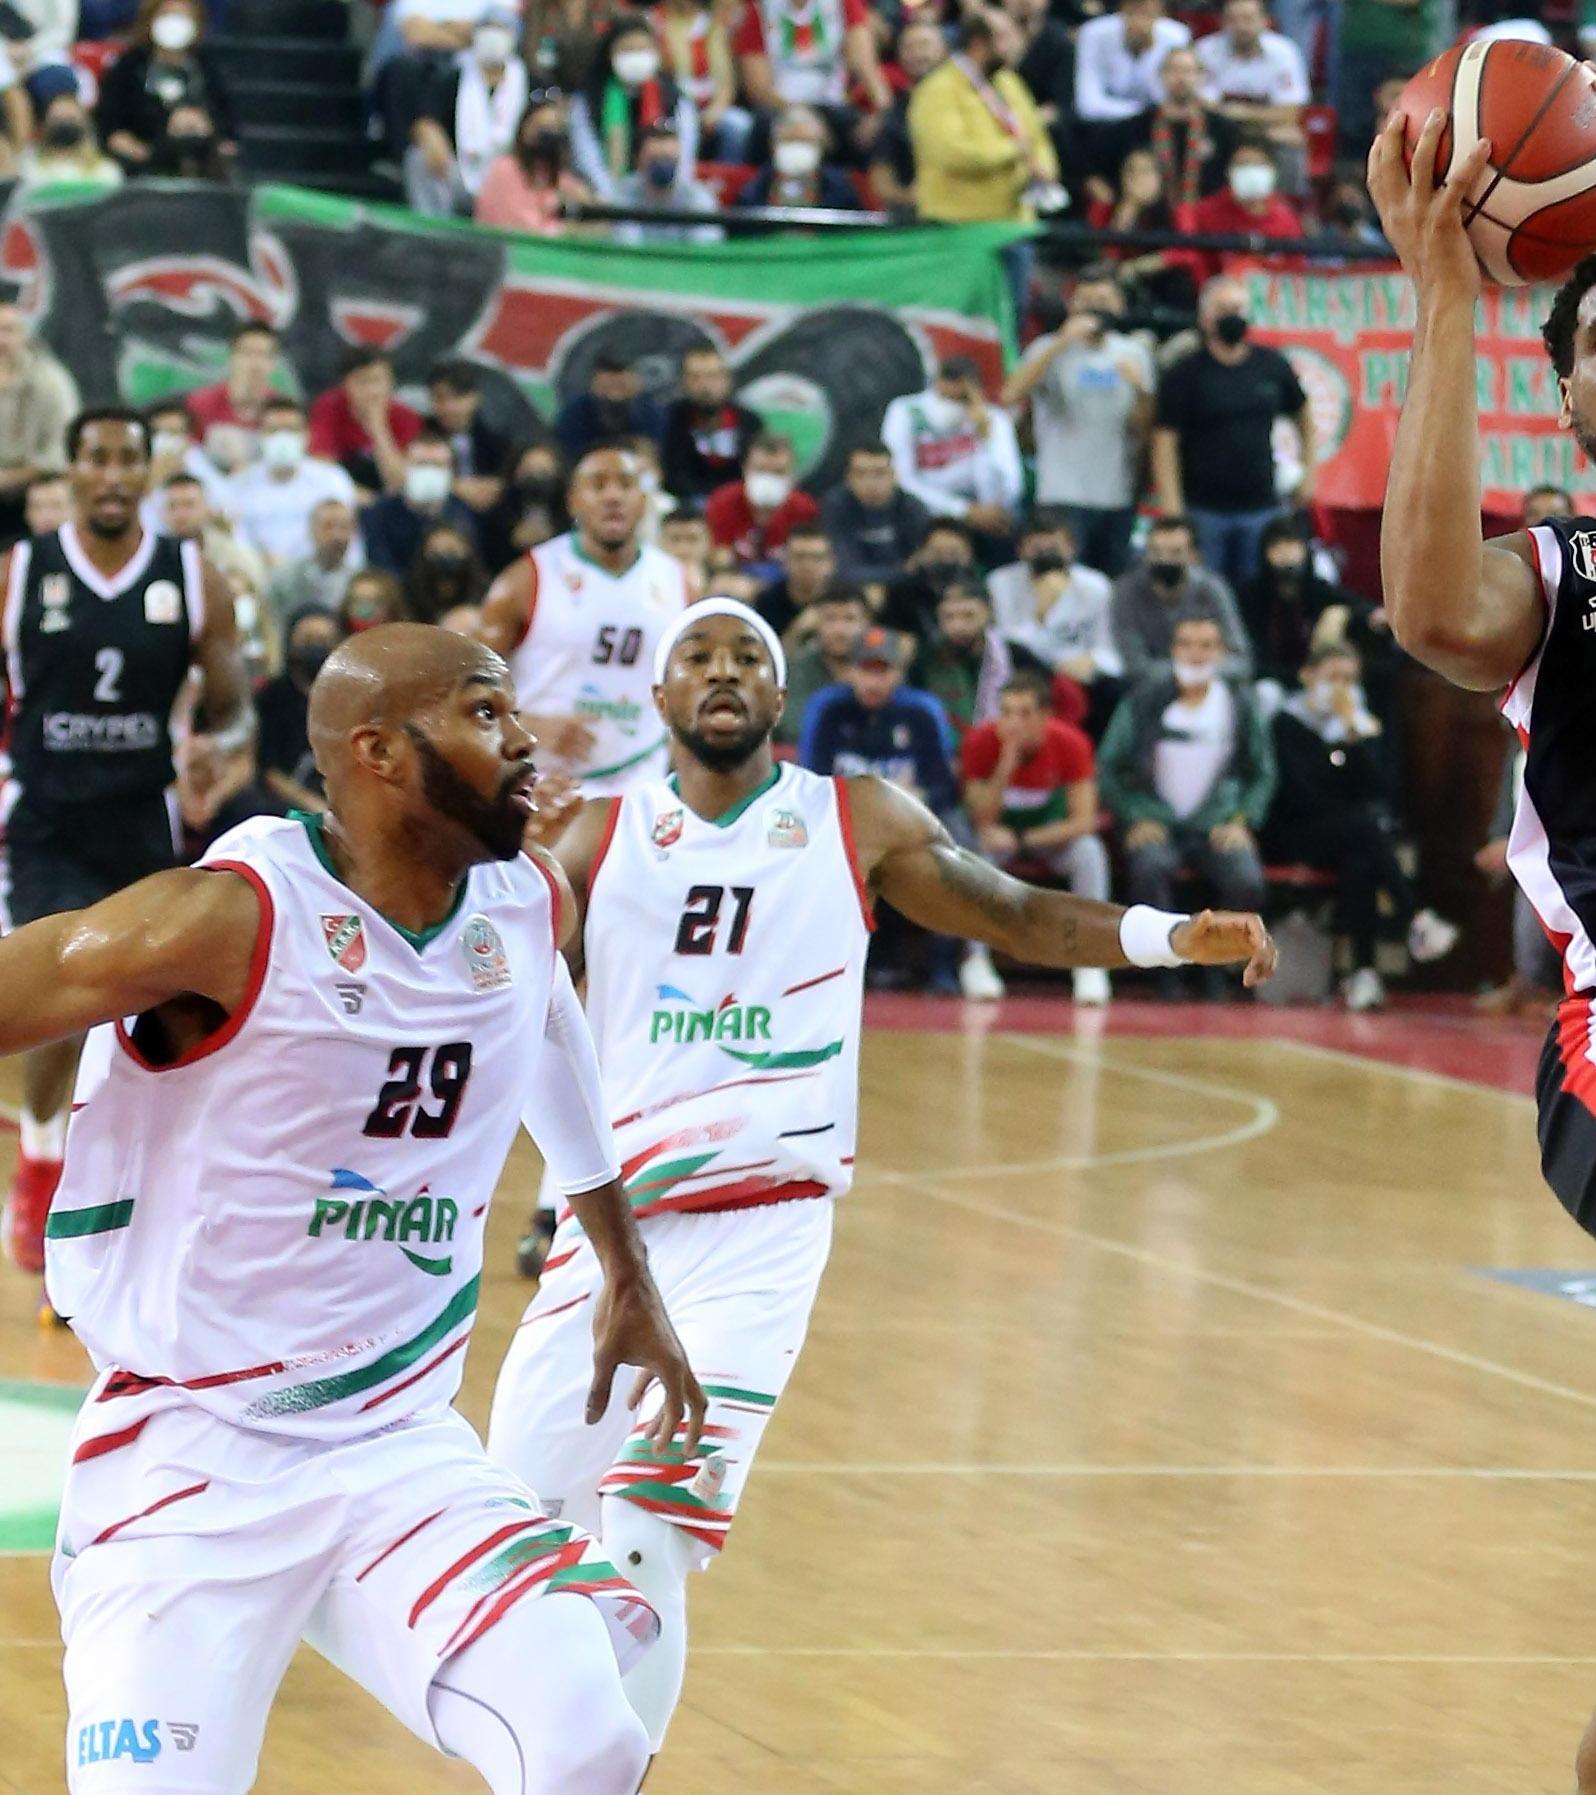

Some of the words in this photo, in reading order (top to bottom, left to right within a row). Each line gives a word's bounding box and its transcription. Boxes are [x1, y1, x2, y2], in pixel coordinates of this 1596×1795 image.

[592, 625, 643, 667] 50
[93, 647, 124, 703] 2
[674, 885, 755, 955] 21
[649, 1006, 772, 1043] PINAR
[363, 1042, 473, 1138] 29
[307, 1197, 459, 1243] PINAR
